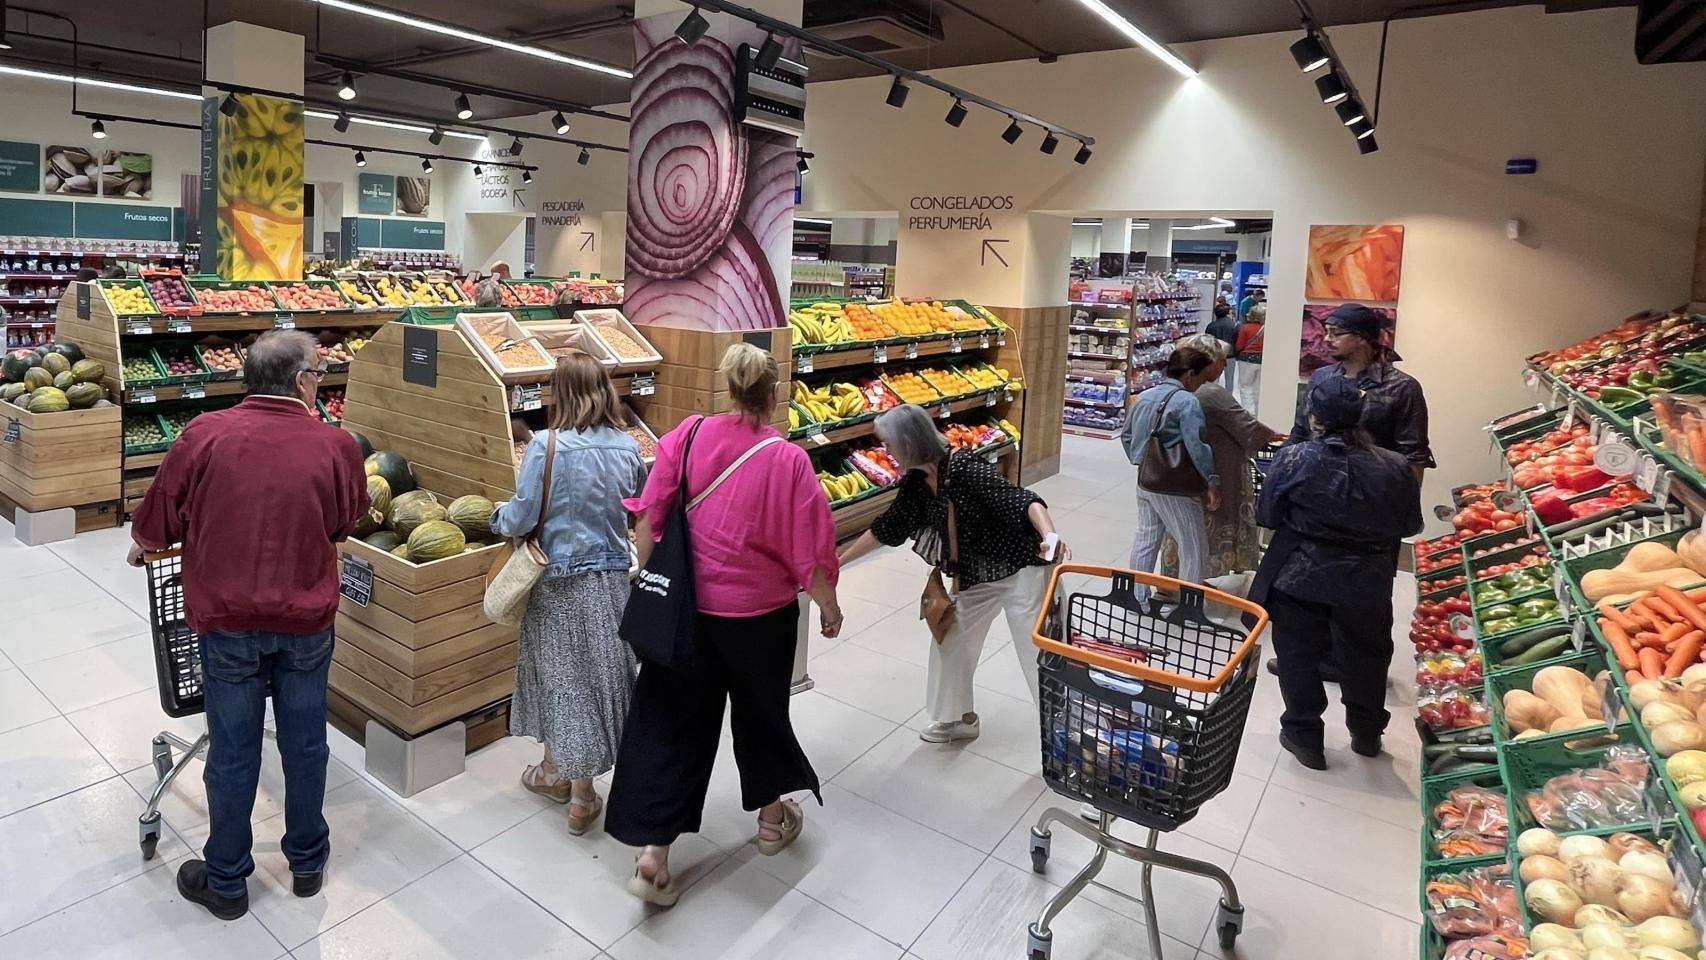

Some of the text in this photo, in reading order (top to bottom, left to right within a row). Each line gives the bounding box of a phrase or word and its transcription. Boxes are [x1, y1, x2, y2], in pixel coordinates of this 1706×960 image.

[481, 189, 508, 199] BODEGA
[542, 198, 585, 212] PESCADERÍA
[910, 195, 1014, 210] CONGELADOS
[124, 212, 147, 221] Frutos
[541, 214, 582, 226] PANADERÍA
[909, 212, 992, 230] PERFUMERÍA
